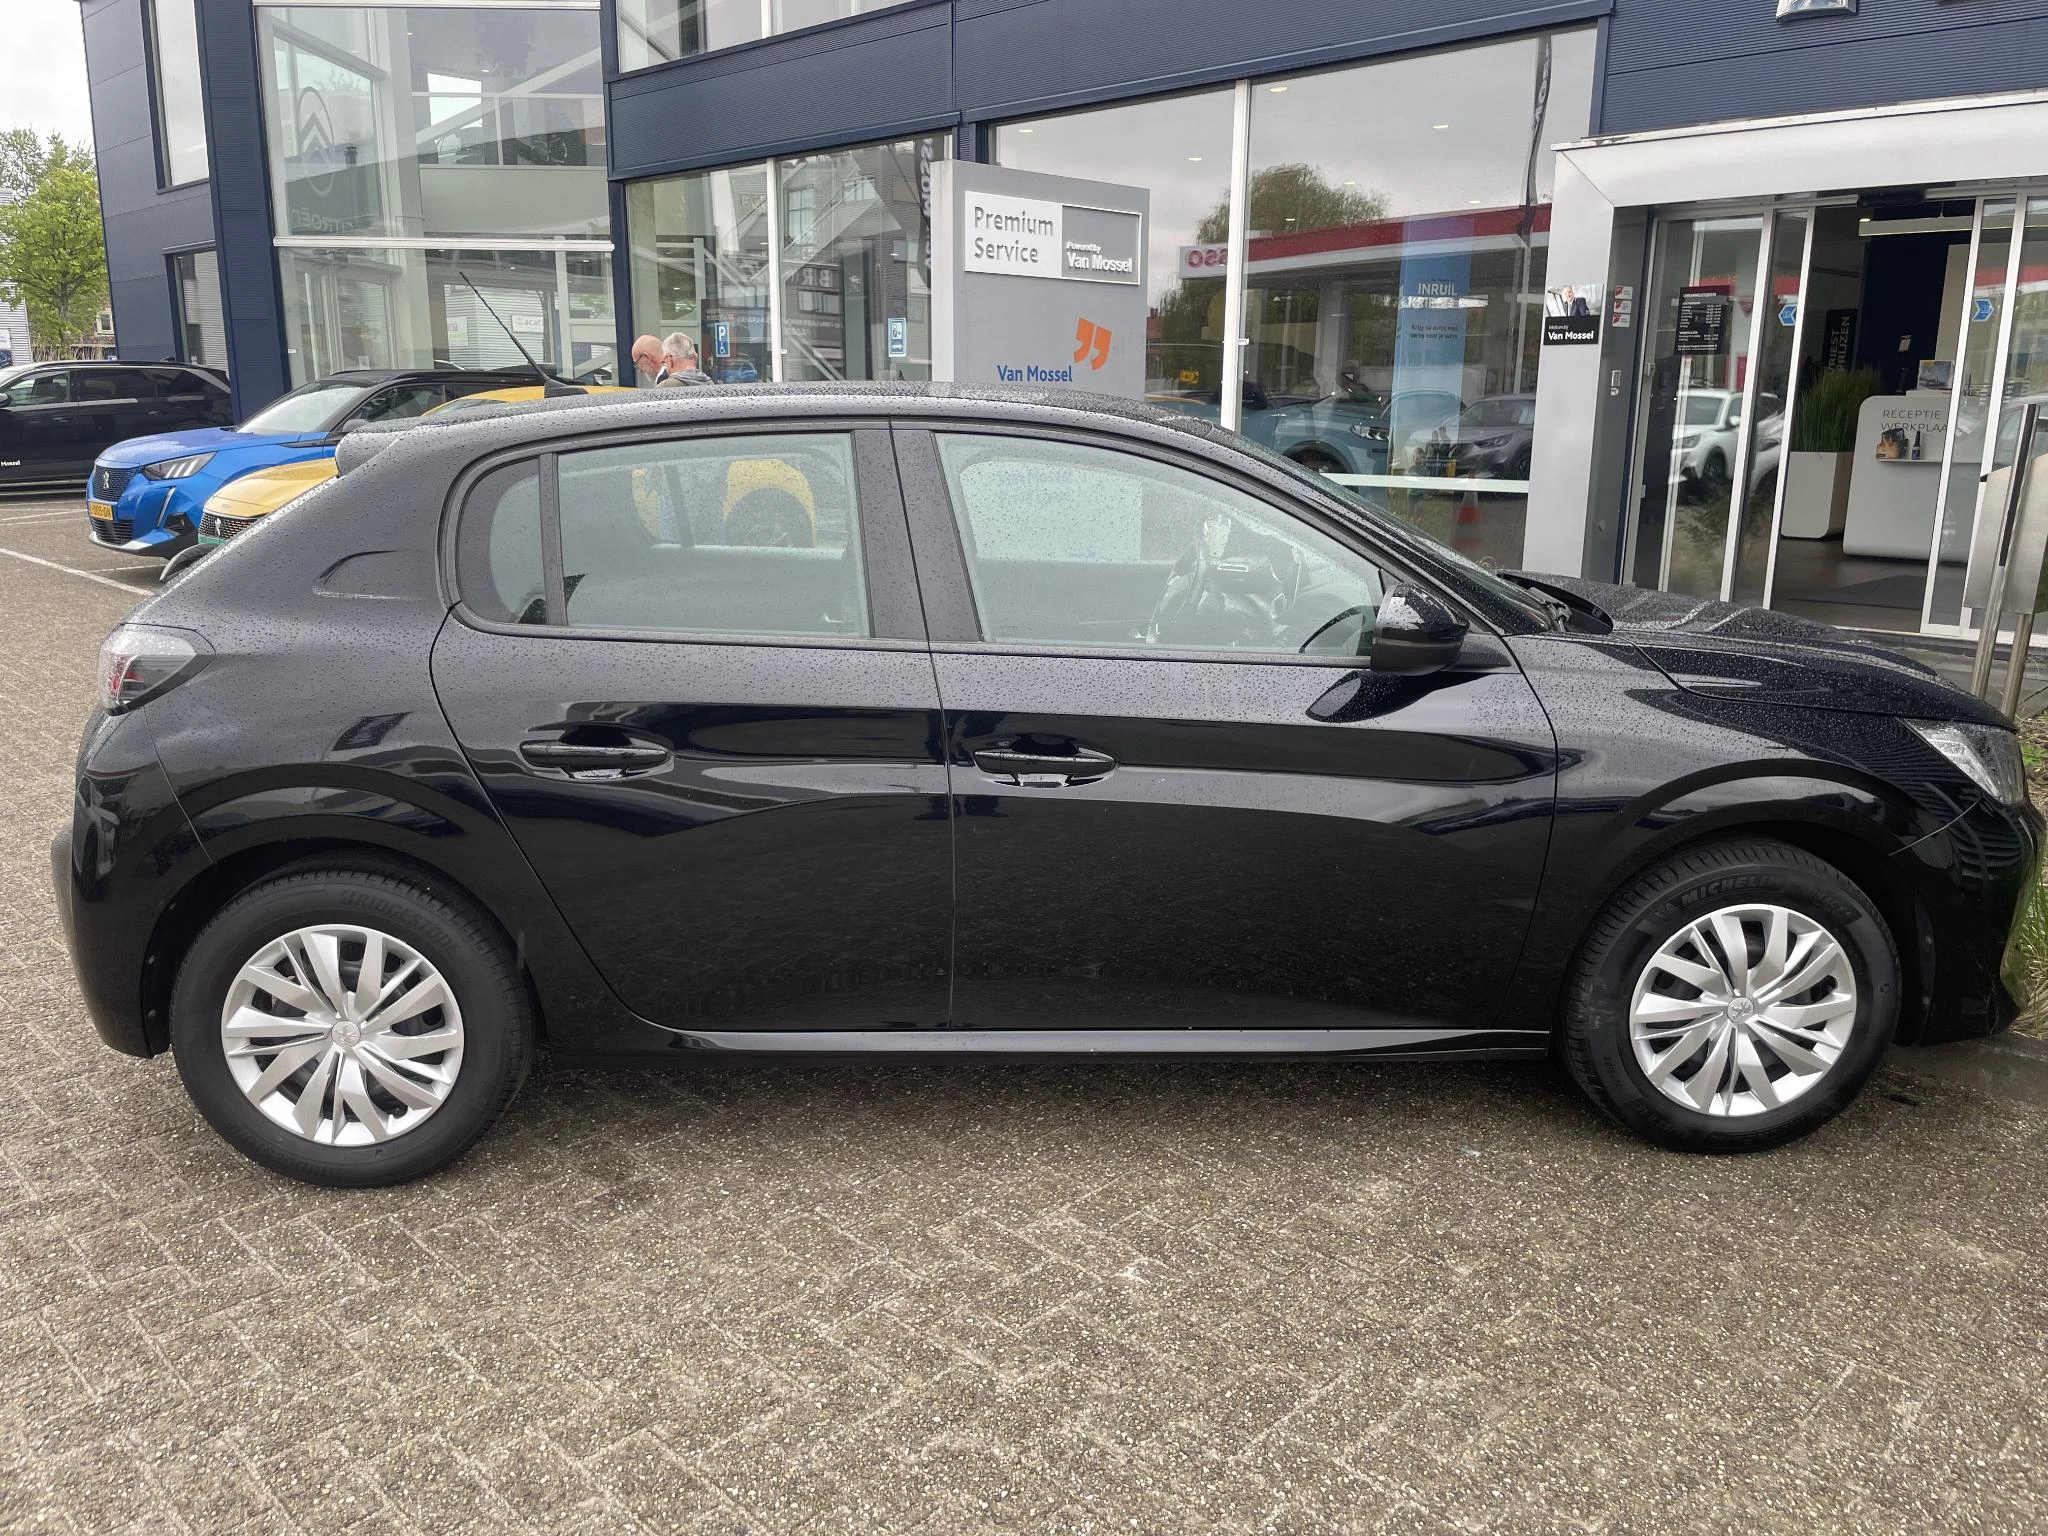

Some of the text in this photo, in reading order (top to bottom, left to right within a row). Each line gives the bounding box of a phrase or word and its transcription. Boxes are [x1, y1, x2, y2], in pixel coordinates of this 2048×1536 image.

[974, 206, 1054, 236] Premium
[974, 237, 1039, 263] Service
[1067, 252, 1133, 273] Van Mossel
[1418, 282, 1458, 296] INRUIL
[718, 326, 726, 341] P
[1547, 330, 1594, 340] Van Mossel
[1836, 315, 1851, 372] PRIJZEN
[997, 365, 1073, 382] Van Mossel
[1882, 409, 1943, 420] RECEPTIE
